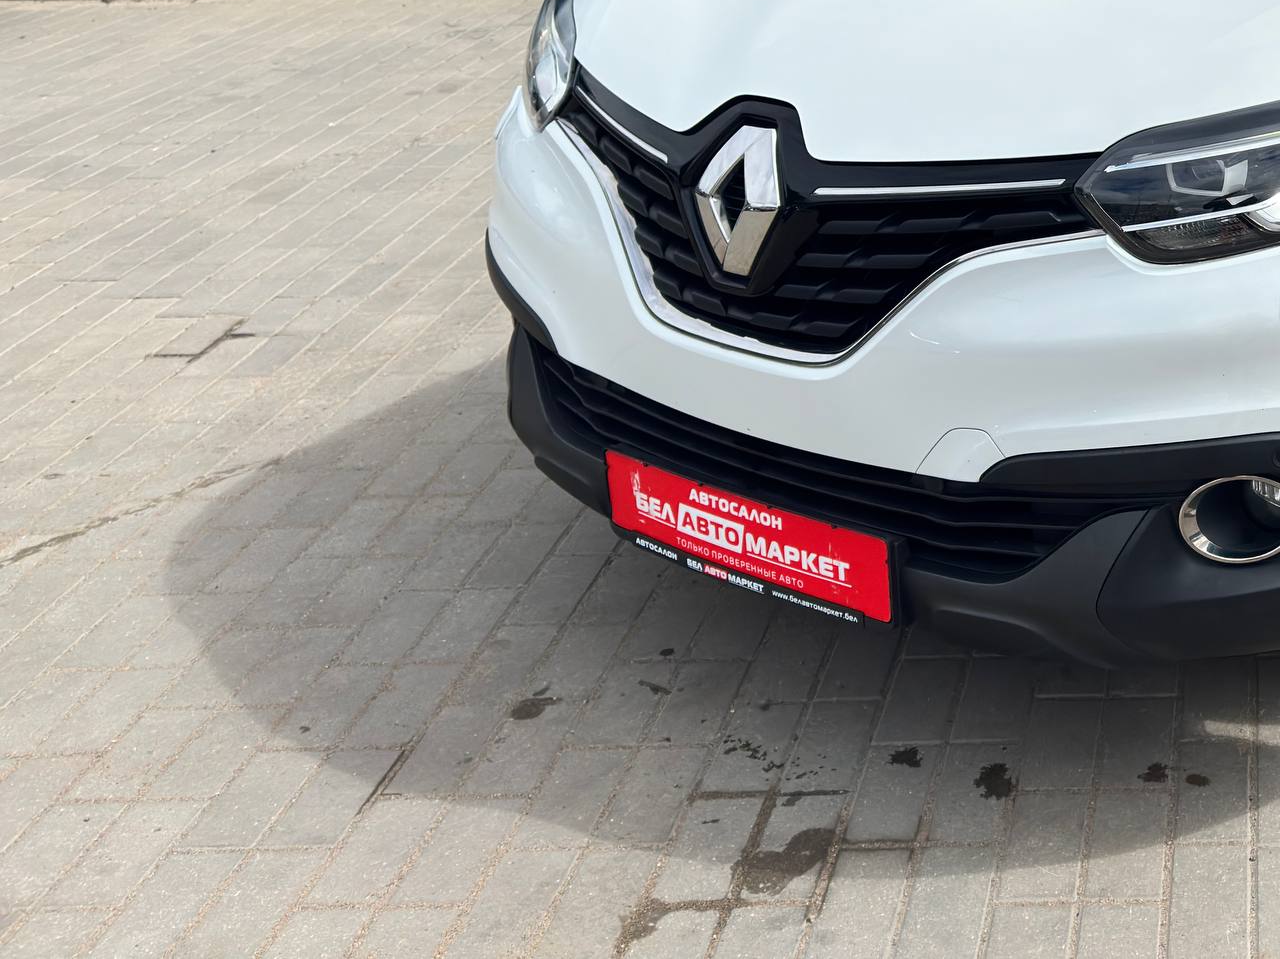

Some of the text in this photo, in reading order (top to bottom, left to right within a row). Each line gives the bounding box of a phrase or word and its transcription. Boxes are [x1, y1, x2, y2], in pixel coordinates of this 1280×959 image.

[635, 492, 850, 582] БЕЛ АВТО МАРКЕТ
[689, 488, 783, 531] АВТОСАЛОН
[635, 537, 858, 623] АВТОСАЛОН БЕЛ АВТО МАРКЕТ www.белавтомаркет.бел
[676, 536, 804, 589] ТОЛЬКО ПРОВЕРЕННЫЕ АВТО
